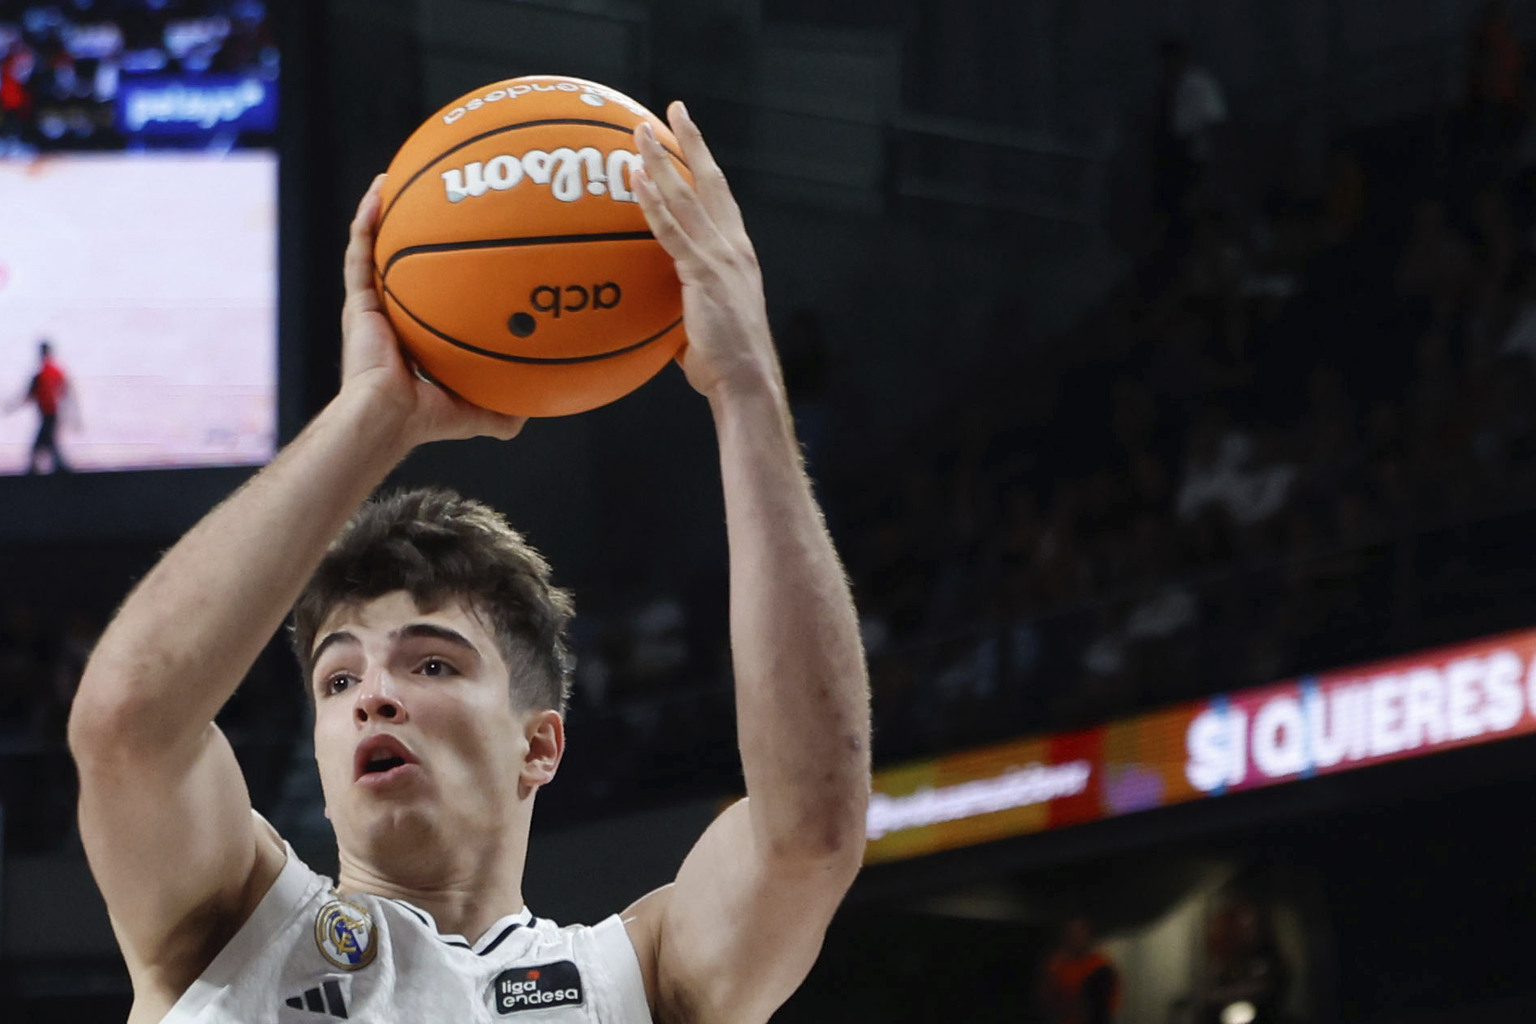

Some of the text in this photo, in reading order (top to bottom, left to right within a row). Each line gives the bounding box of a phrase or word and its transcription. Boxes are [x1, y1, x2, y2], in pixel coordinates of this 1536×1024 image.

[443, 83, 579, 125] endesa
[530, 282, 621, 318] acb
[1186, 705, 1248, 792] SI
[1252, 649, 1524, 777] QUIERES
[502, 980, 537, 995] liga
[502, 989, 579, 1008] endesa
